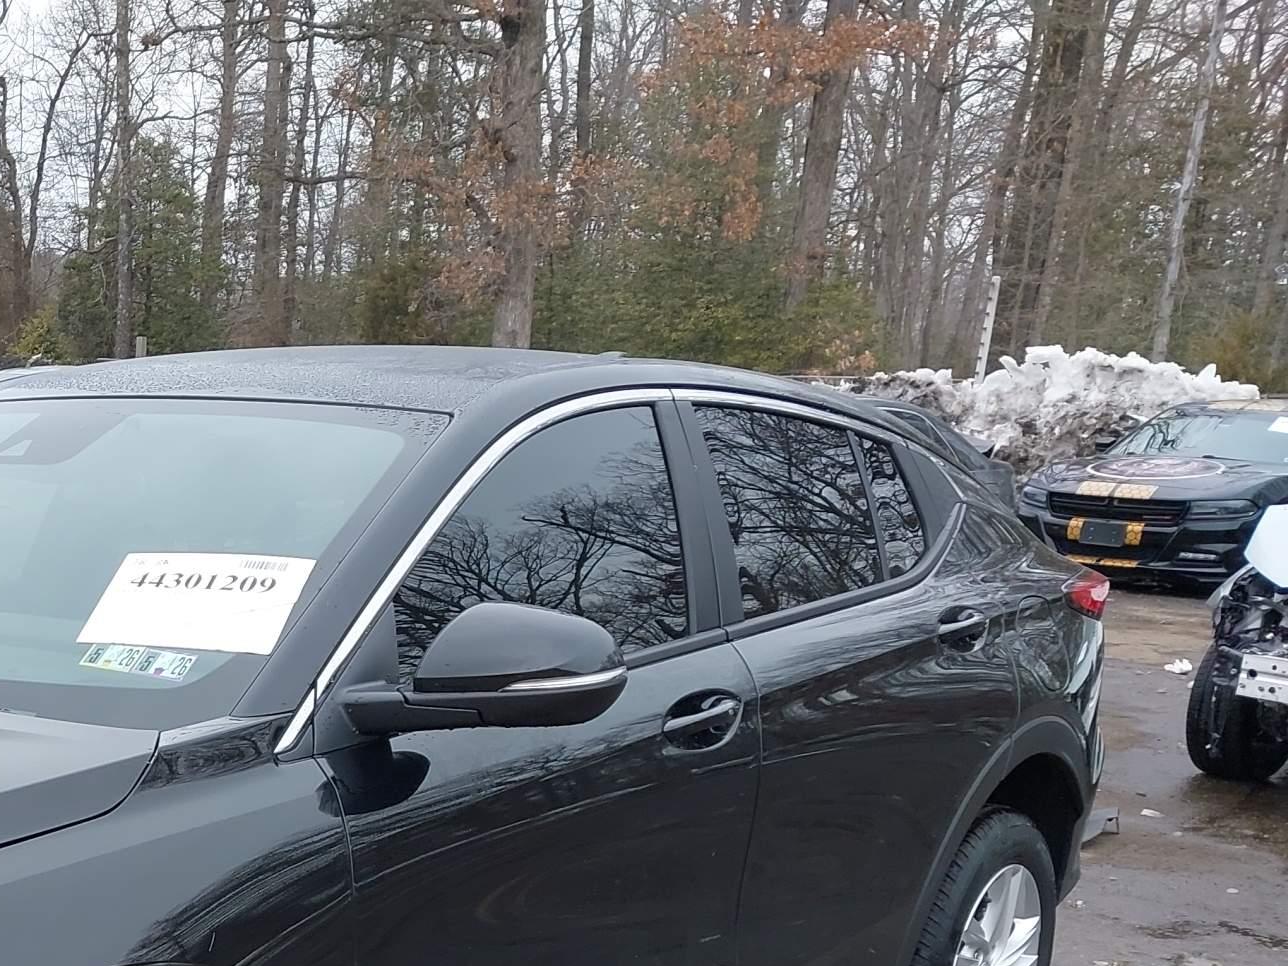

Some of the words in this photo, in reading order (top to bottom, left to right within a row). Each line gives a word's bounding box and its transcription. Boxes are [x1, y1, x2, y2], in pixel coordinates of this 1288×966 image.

[130, 571, 277, 593] 44301209
[89, 647, 104, 664] 5
[118, 648, 140, 667] 26
[140, 655, 155, 672] 5
[170, 656, 193, 676] 26
